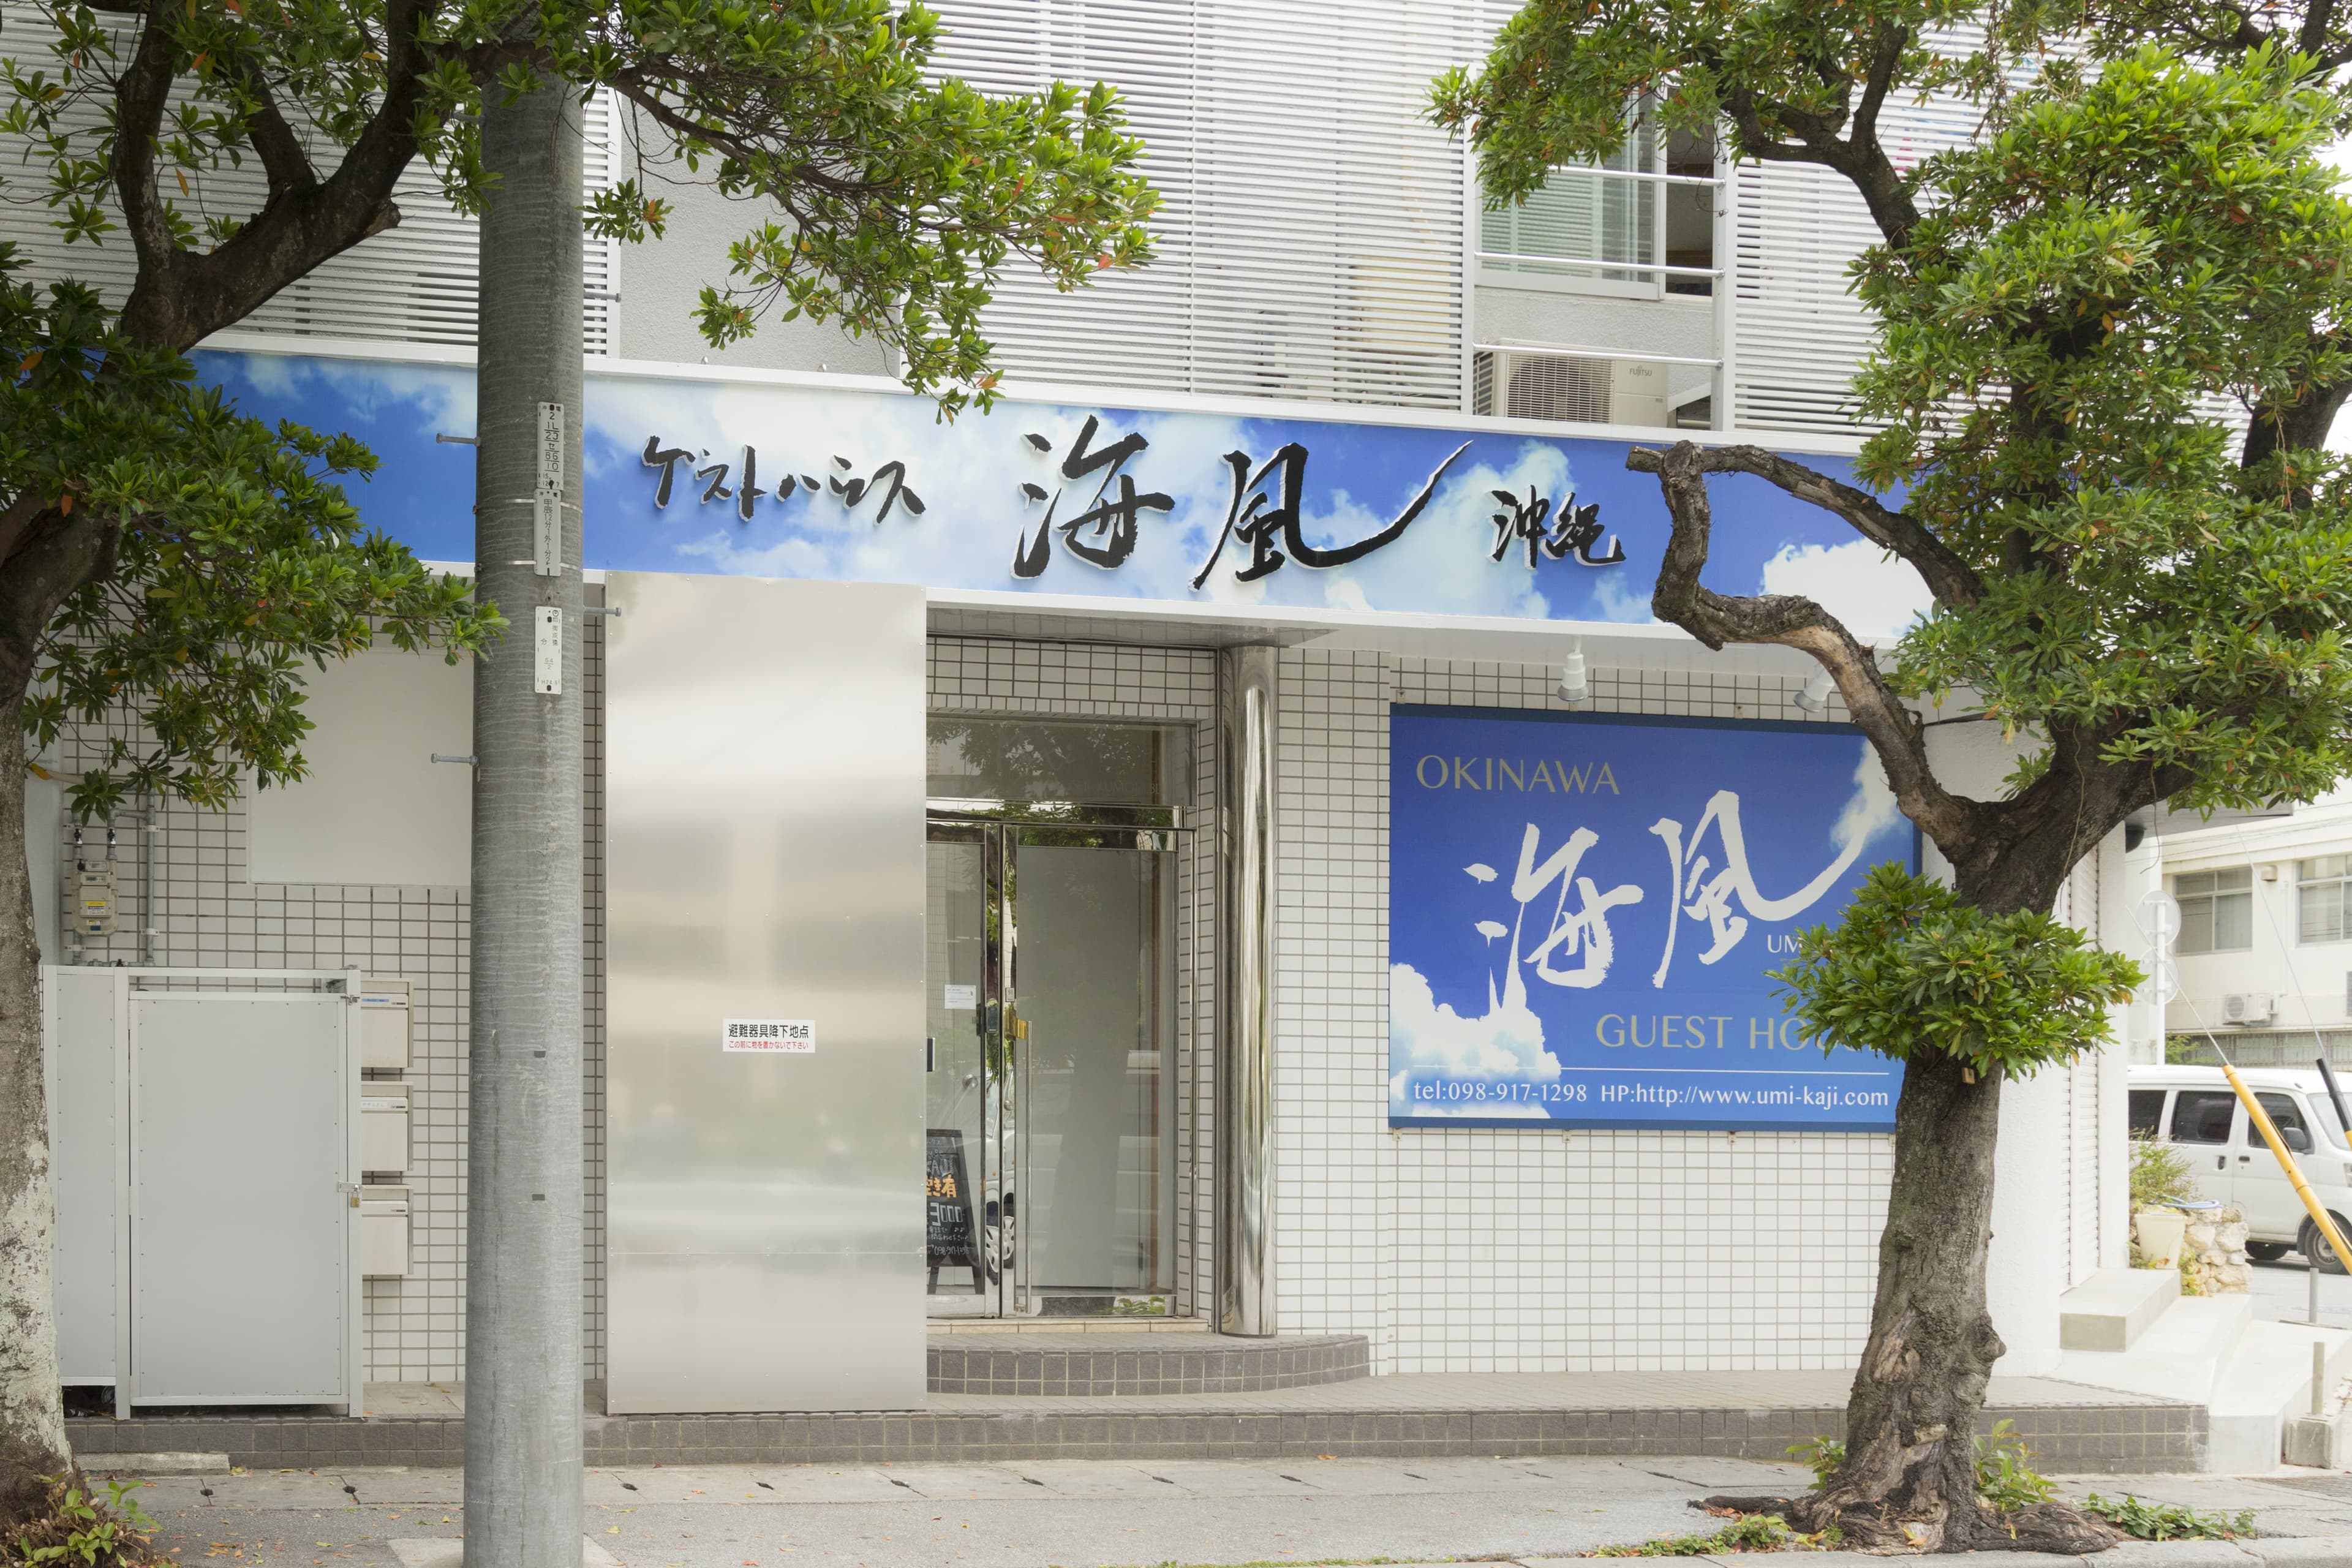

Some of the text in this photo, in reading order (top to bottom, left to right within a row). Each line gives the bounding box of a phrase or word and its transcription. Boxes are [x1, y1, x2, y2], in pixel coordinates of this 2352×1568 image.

[1629, 368, 1653, 377] FUJITSU
[641, 414, 1627, 592] ゲストハウス 海風 沖縄
[1416, 755, 1620, 795] OKINAWA
[1463, 790, 1872, 1011] 海風
[1768, 934, 1803, 953] UM
[728, 1023, 809, 1039] 避難器具降下地点
[729, 1041, 809, 1049] この前に物を置かないで下さい
[1596, 1014, 1733, 1049] GUEST
[1414, 1080, 1889, 1110] tel:098-917-1298 HP:http://www.umi-kaji.com
